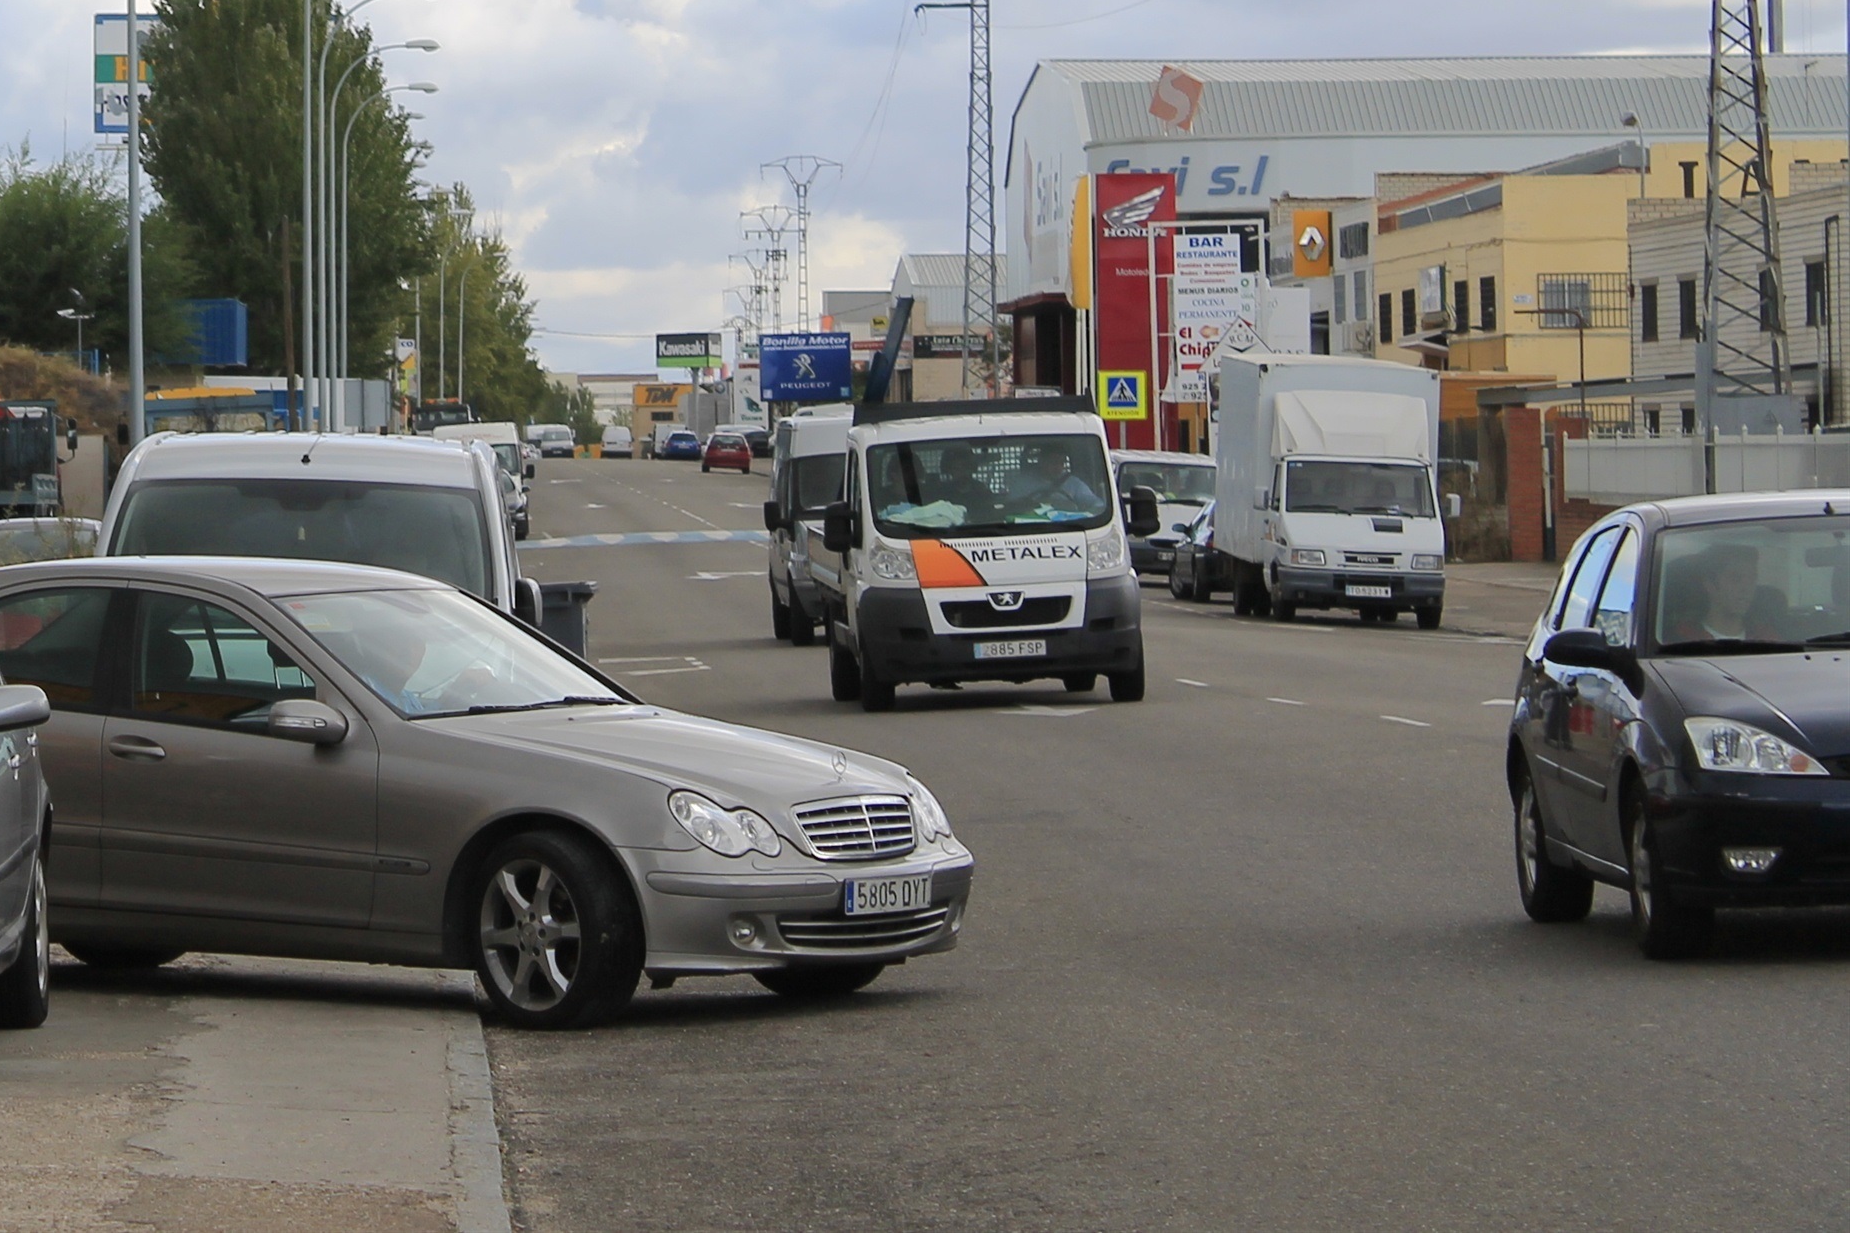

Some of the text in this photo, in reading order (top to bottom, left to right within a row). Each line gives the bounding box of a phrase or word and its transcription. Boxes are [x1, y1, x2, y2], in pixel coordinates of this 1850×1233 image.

[1189, 237, 1223, 247] BAR
[1176, 251, 1238, 259] RESTAURANTE
[1115, 268, 1149, 276] Motoled
[1192, 298, 1225, 306] COCINA
[1178, 310, 1238, 319] PERMANENTE
[763, 336, 848, 345] Bonilla Motor
[658, 340, 706, 356] Kawasaki
[971, 545, 1082, 563] METALEX
[1018, 642, 1043, 654] FSP
[858, 881, 897, 908] 5805
[902, 878, 928, 906] DYT
